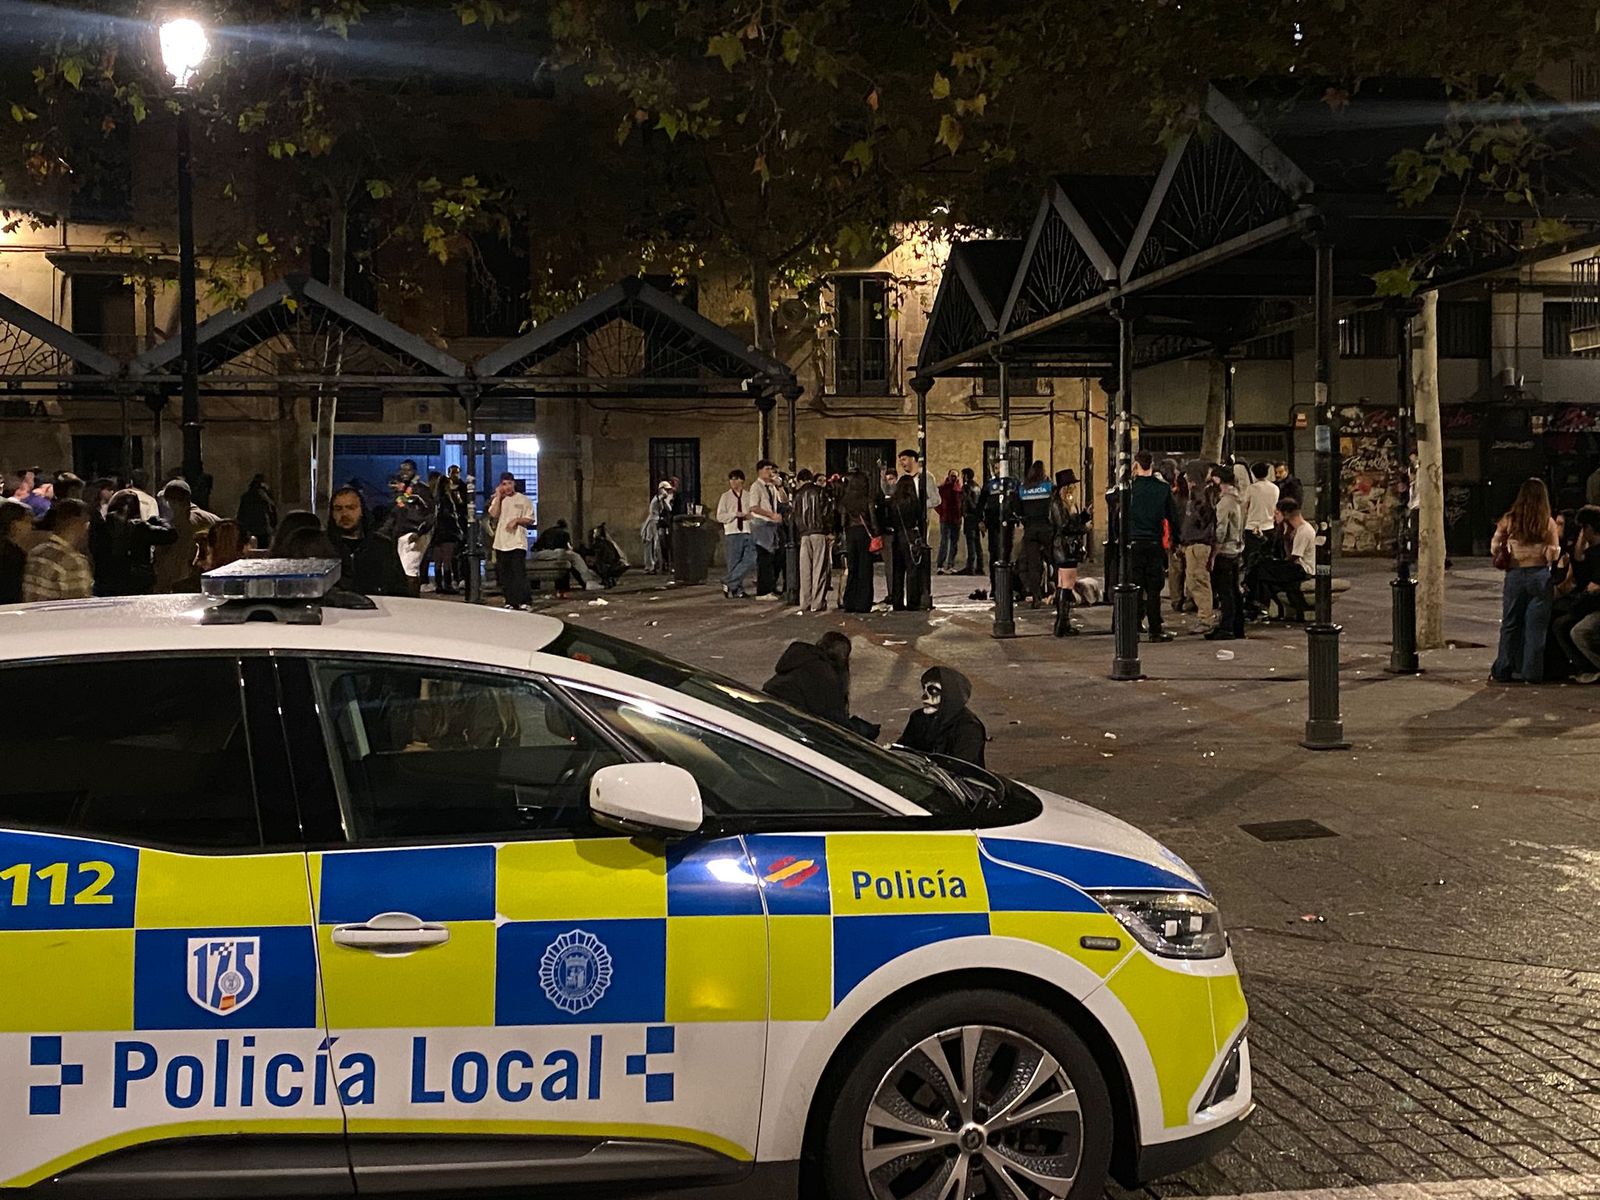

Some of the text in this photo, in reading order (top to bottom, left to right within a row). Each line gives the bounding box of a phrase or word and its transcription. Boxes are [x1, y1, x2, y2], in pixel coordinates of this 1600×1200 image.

[0, 861, 115, 906] 112
[852, 869, 967, 900] Policía
[193, 942, 254, 1007] 175
[112, 1035, 603, 1108] Policía Local
